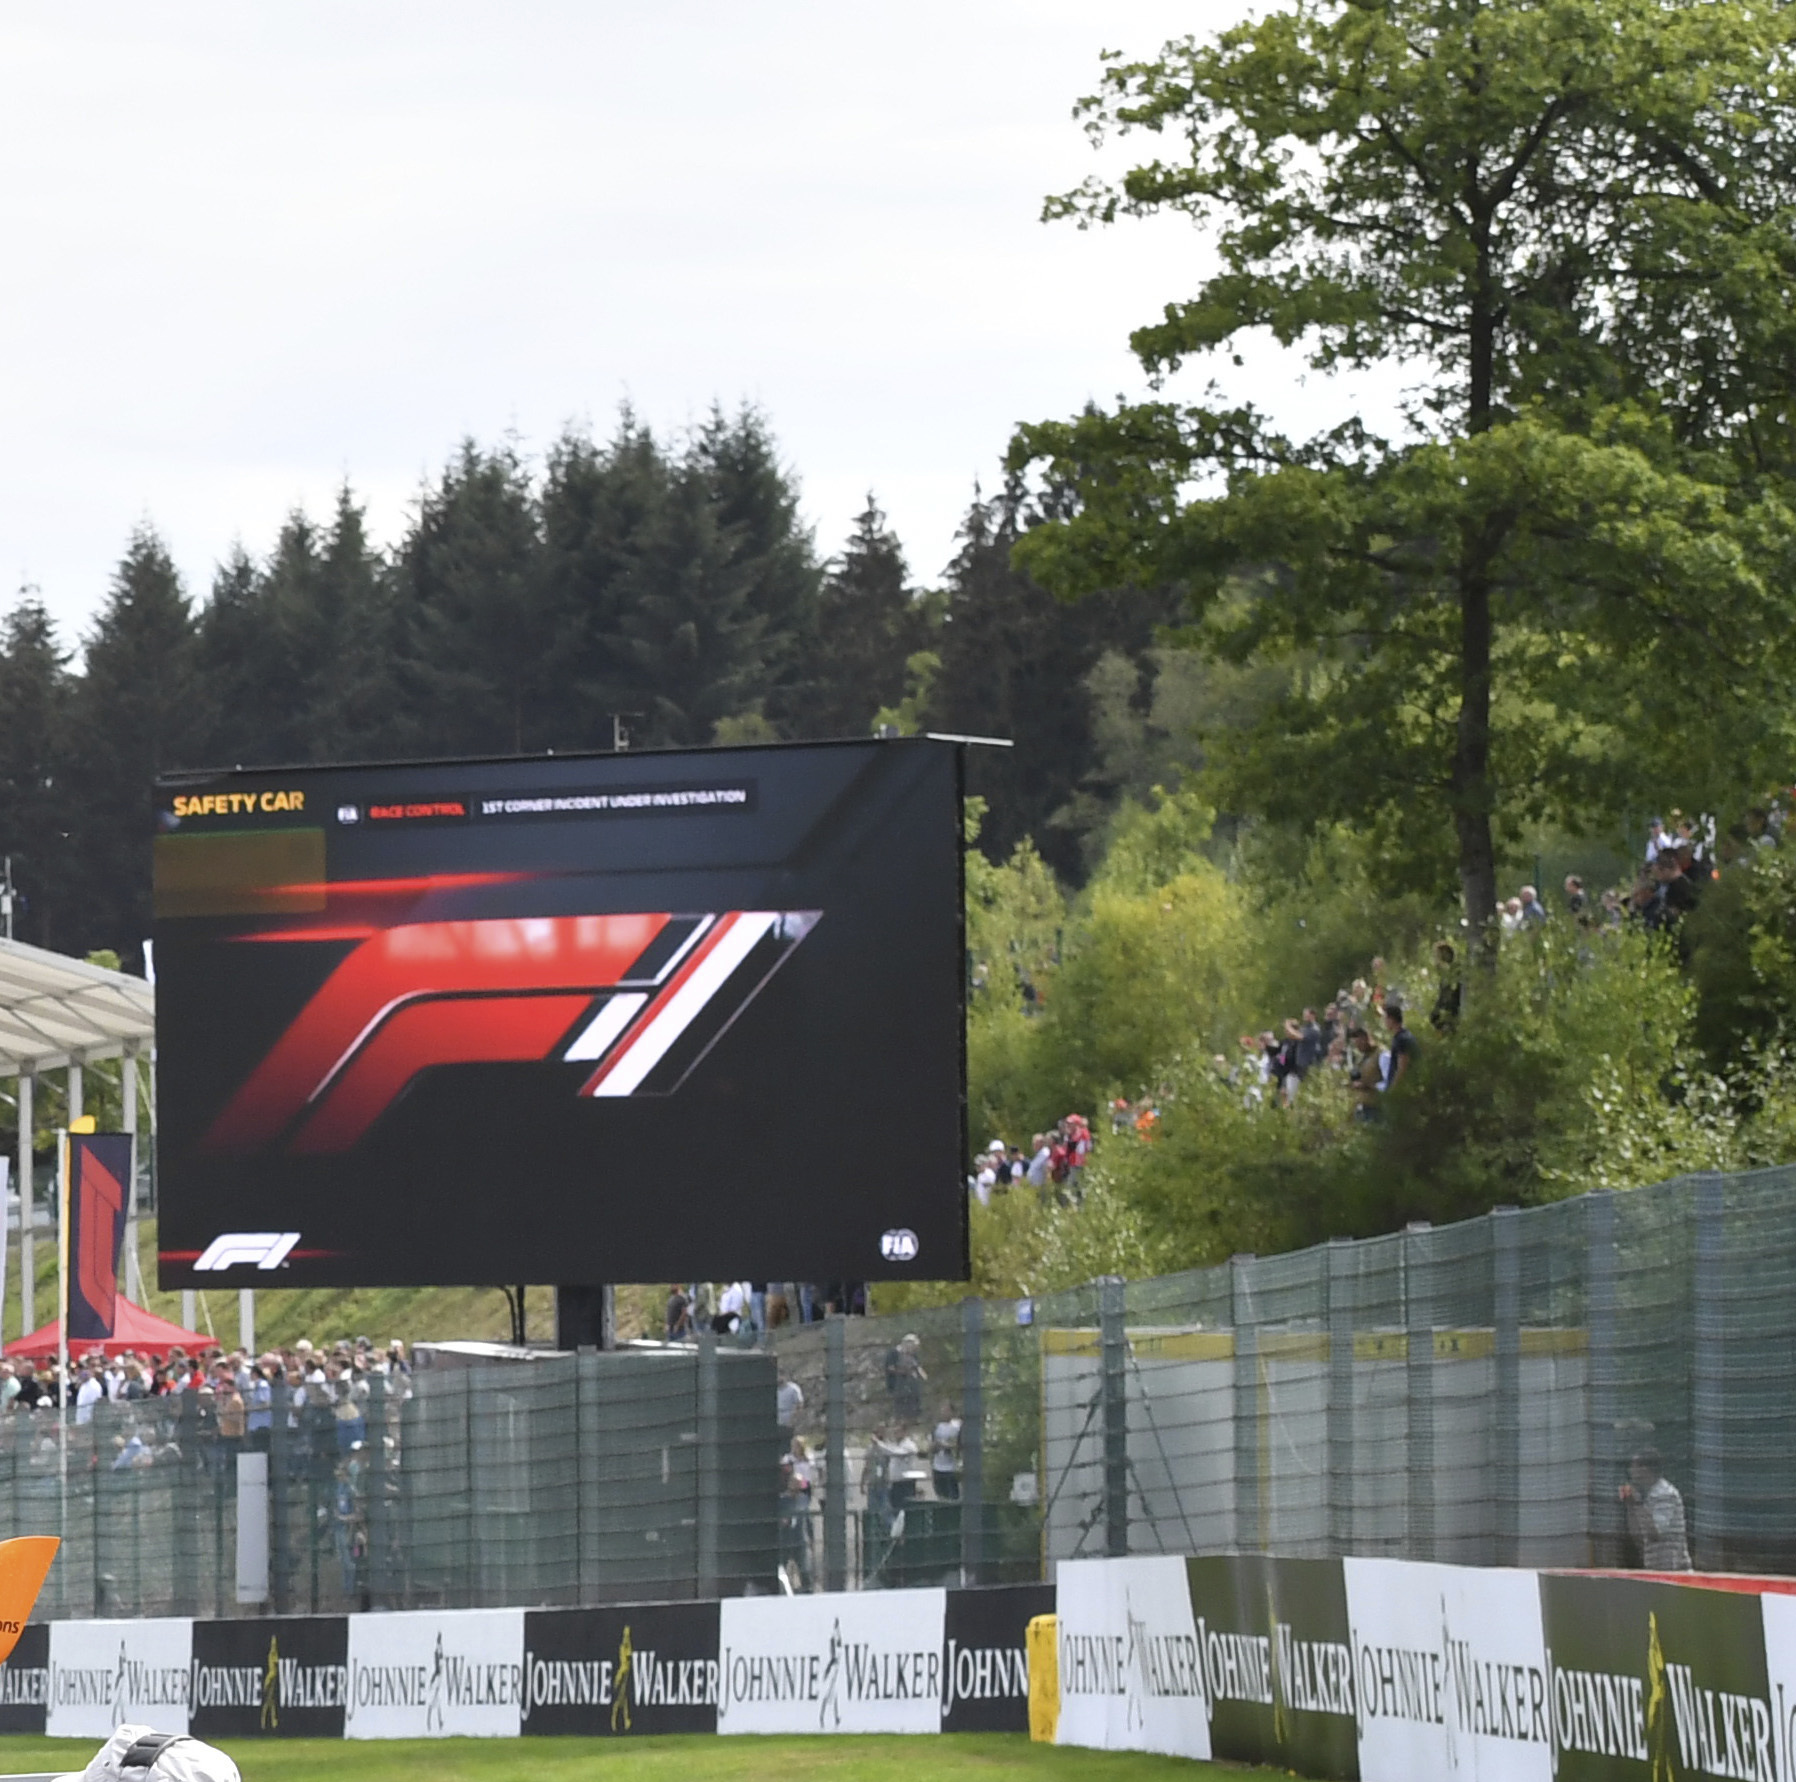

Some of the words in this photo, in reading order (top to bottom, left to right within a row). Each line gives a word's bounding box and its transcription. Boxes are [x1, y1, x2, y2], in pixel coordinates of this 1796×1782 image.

[173, 793, 257, 817] SAFETY
[260, 790, 305, 813] CAR
[406, 802, 466, 817] CONTROL
[482, 801, 503, 814] 1ST
[554, 795, 607, 811] INCIDENT
[609, 793, 650, 809] UNDER
[653, 788, 746, 807] INVESTIGATION
[880, 1232, 916, 1258] FIA
[47, 1660, 112, 1718] JOHNNIE
[126, 1660, 191, 1706] WALKER
[189, 1657, 264, 1720] JOHNNIE
[277, 1657, 348, 1706] WALKER
[348, 1657, 427, 1721] JOHNNIE
[444, 1655, 521, 1706] WALKER
[521, 1651, 612, 1720] JOHNNIE
[630, 1650, 720, 1706] WALKER
[719, 1646, 821, 1719] JOHNNIE
[843, 1642, 940, 1702] WALKER
[942, 1639, 1028, 1718] JOHNN
[1129, 1618, 1202, 1698] WALKER
[1197, 1617, 1273, 1722] JOHNNIE
[1274, 1623, 1355, 1716] WALKER
[1351, 1628, 1445, 1742] JOHNNIE
[1447, 1640, 1550, 1744] WALKER
[1545, 1648, 1649, 1776] JOHNNIE
